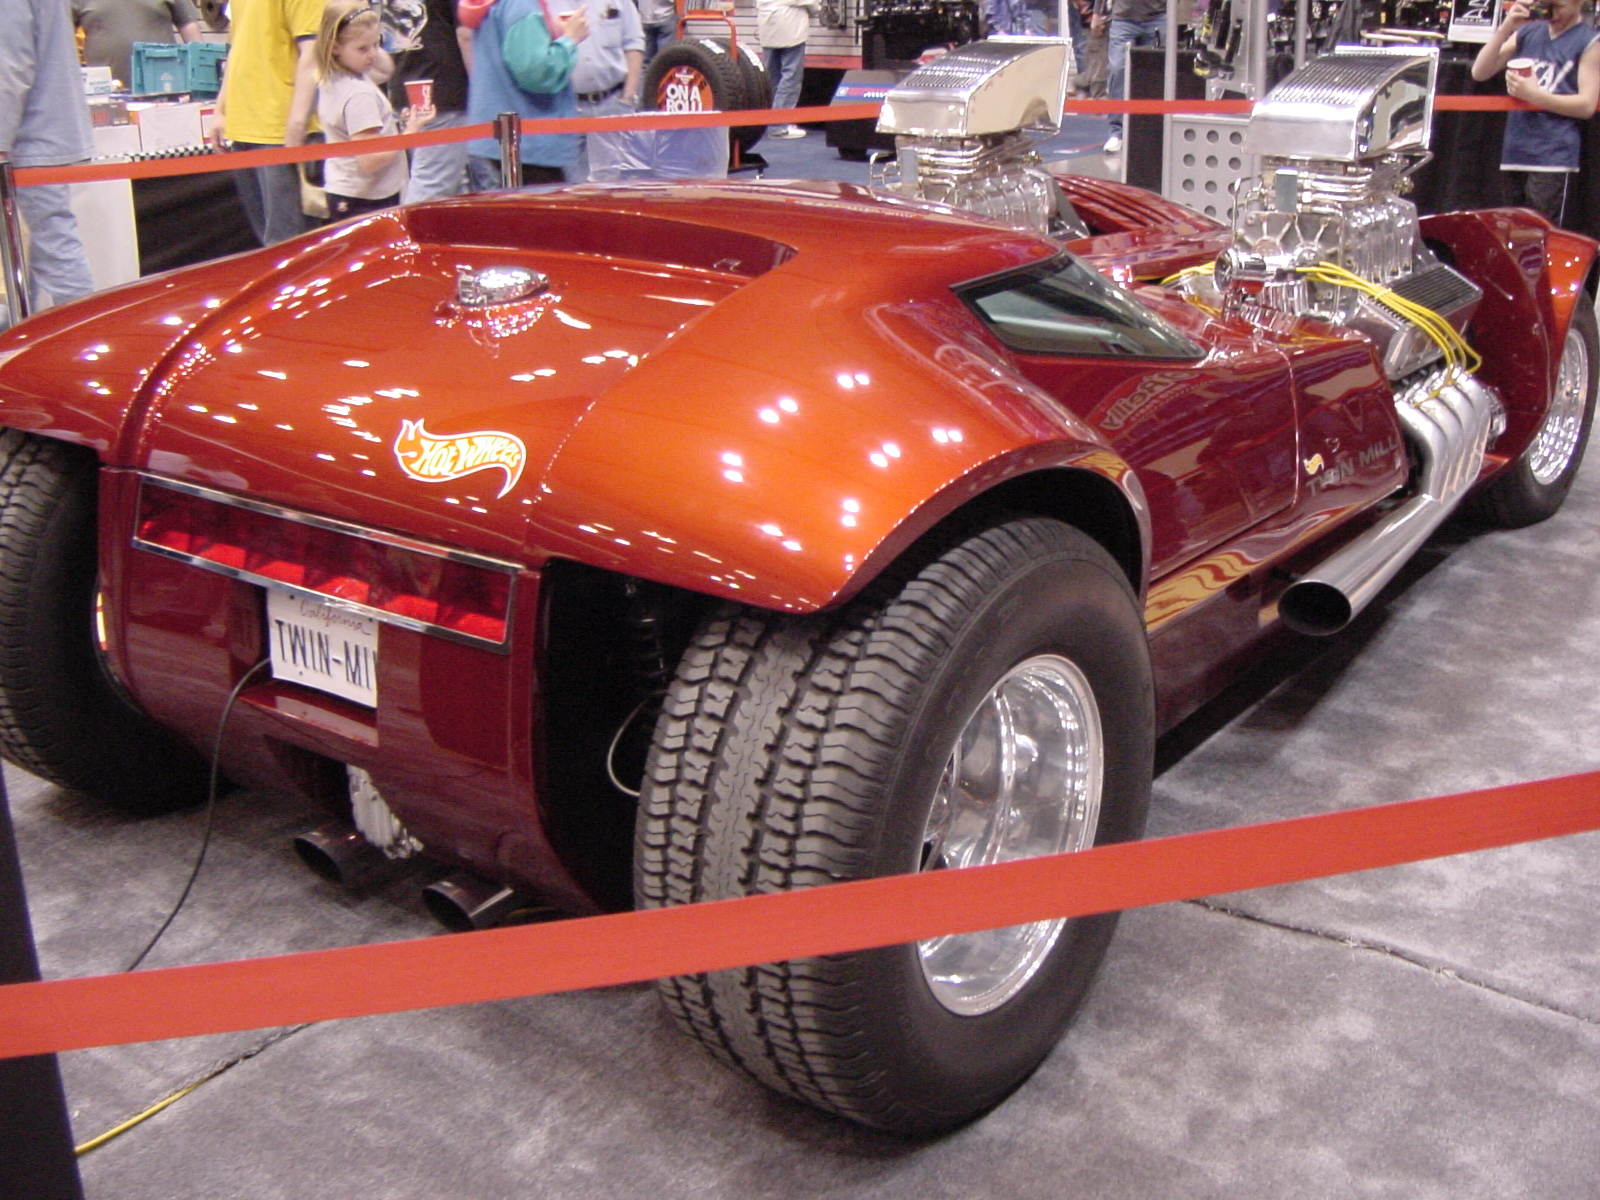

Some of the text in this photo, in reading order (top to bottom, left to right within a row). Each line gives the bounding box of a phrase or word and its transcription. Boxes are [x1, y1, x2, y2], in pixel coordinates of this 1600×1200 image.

[666, 83, 702, 102] ON A
[1359, 436, 1399, 466] MILL
